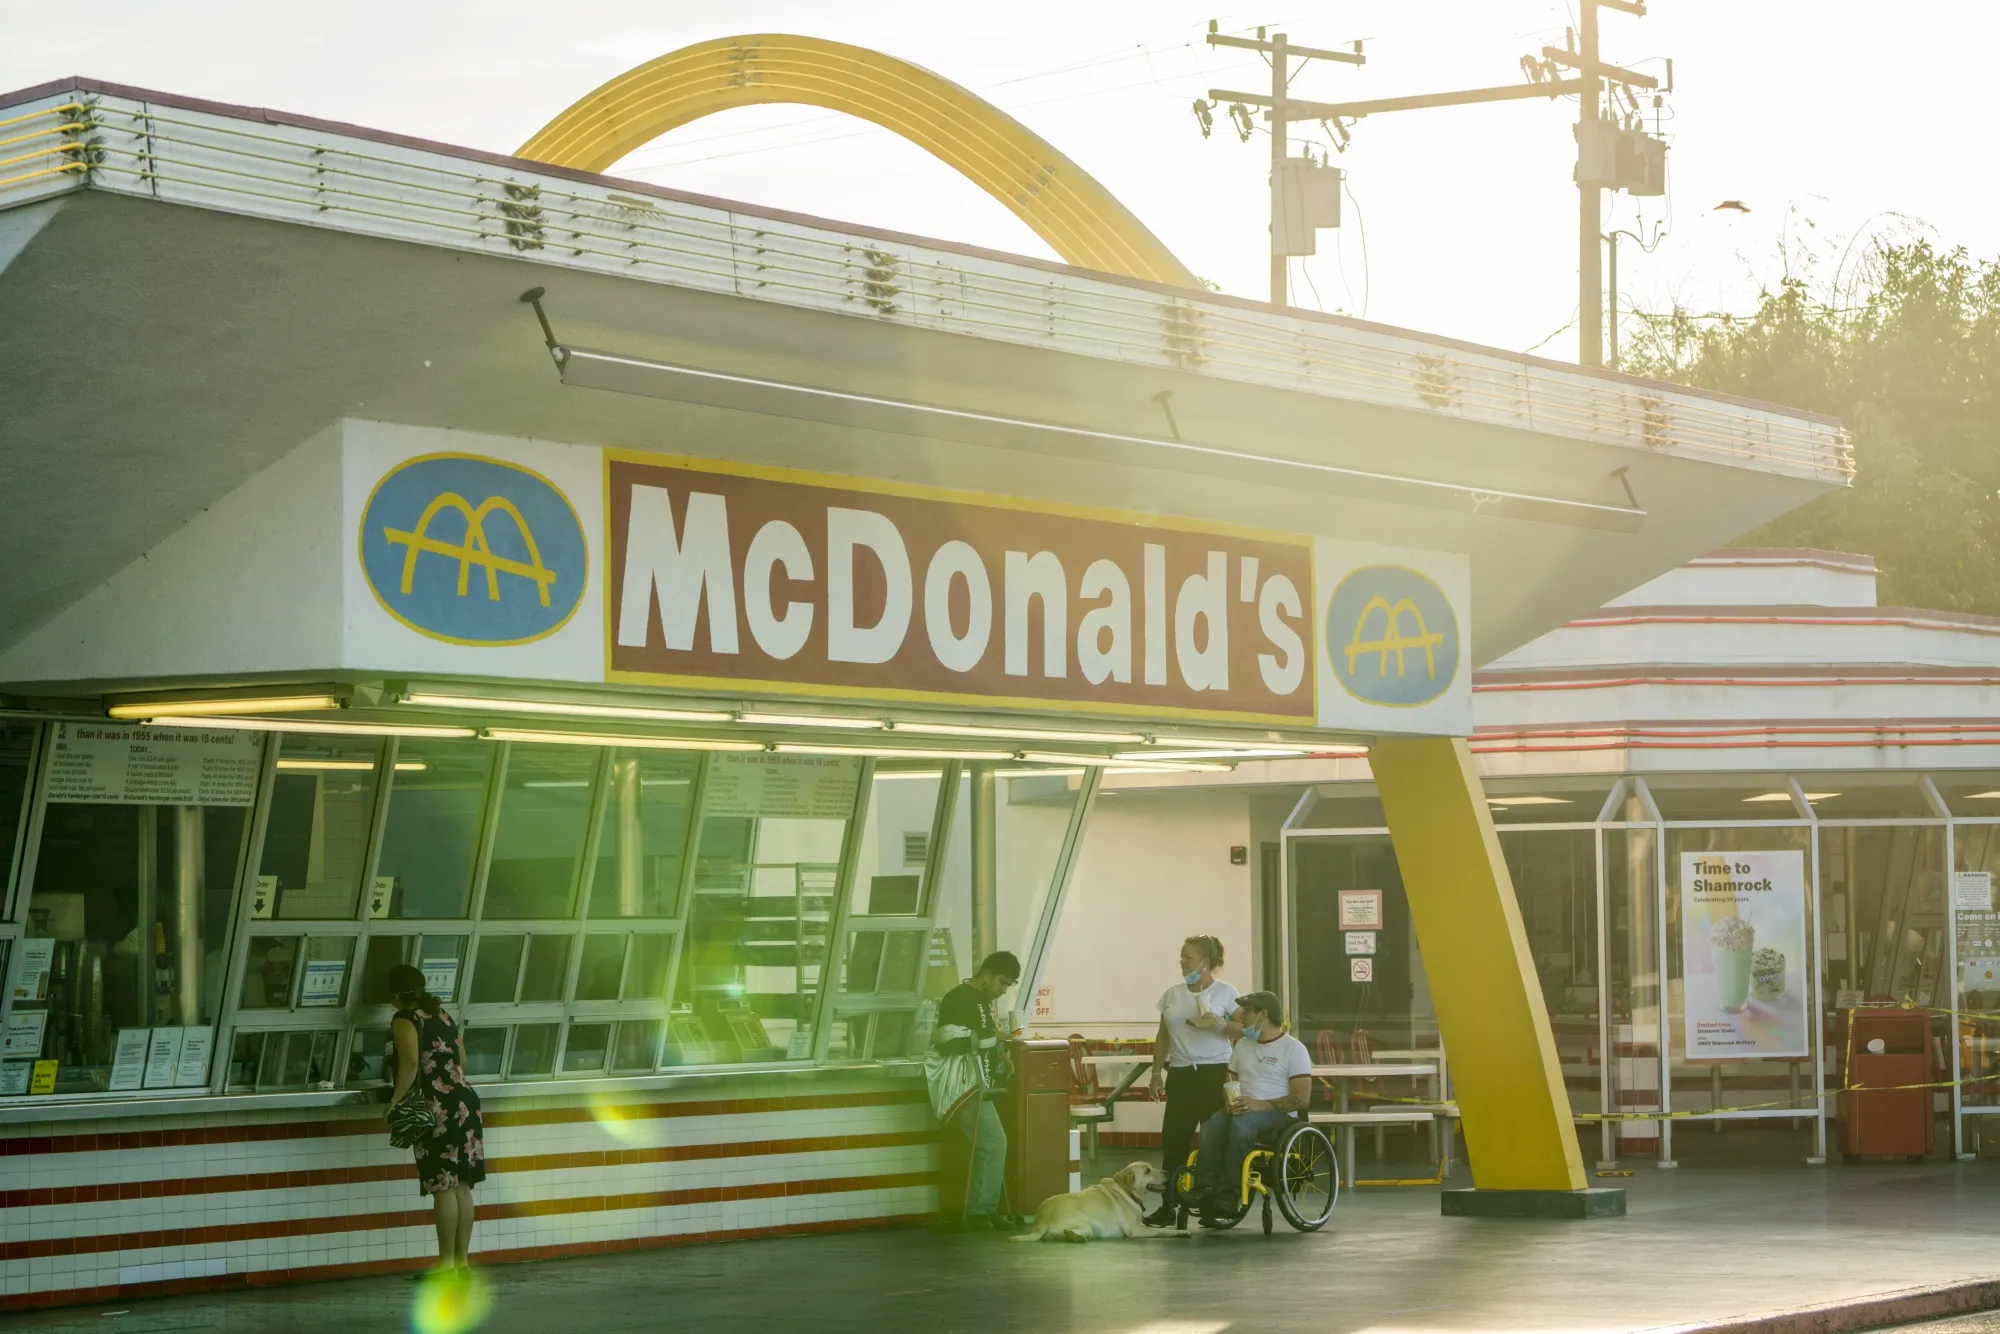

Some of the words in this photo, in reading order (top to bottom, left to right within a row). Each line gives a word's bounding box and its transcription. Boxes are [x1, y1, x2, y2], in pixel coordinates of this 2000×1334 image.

[617, 483, 1306, 696] McDonald's
[77, 728, 94, 739] than
[97, 729, 102, 739] it
[105, 731, 120, 740] was
[122, 730, 129, 740] in
[132, 730, 150, 741] 1955
[153, 732, 174, 742] when
[176, 733, 181, 742] it
[183, 735, 198, 743] was
[201, 734, 209, 743] 15
[211, 735, 235, 744] cents!
[767, 756, 781, 764] 1955
[1692, 861, 1731, 875] Time
[1735, 862, 1750, 874] to
[1693, 878, 1772, 892] Shamrock
